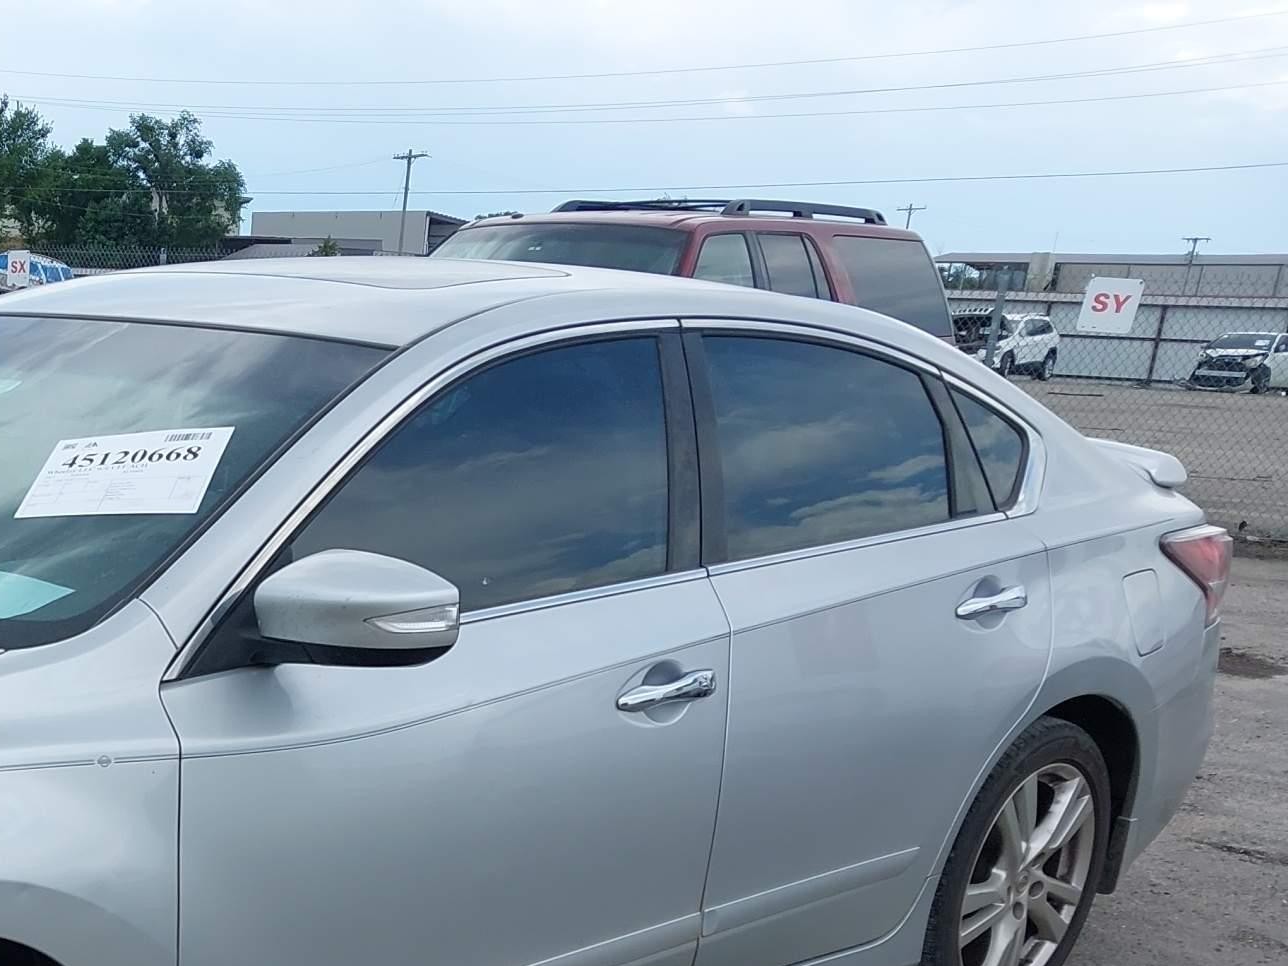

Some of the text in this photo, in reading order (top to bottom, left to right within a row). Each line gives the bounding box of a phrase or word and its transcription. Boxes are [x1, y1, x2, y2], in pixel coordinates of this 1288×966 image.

[11, 260, 26, 273] SX
[1091, 293, 1132, 313] SY
[62, 446, 202, 468] 45120668
